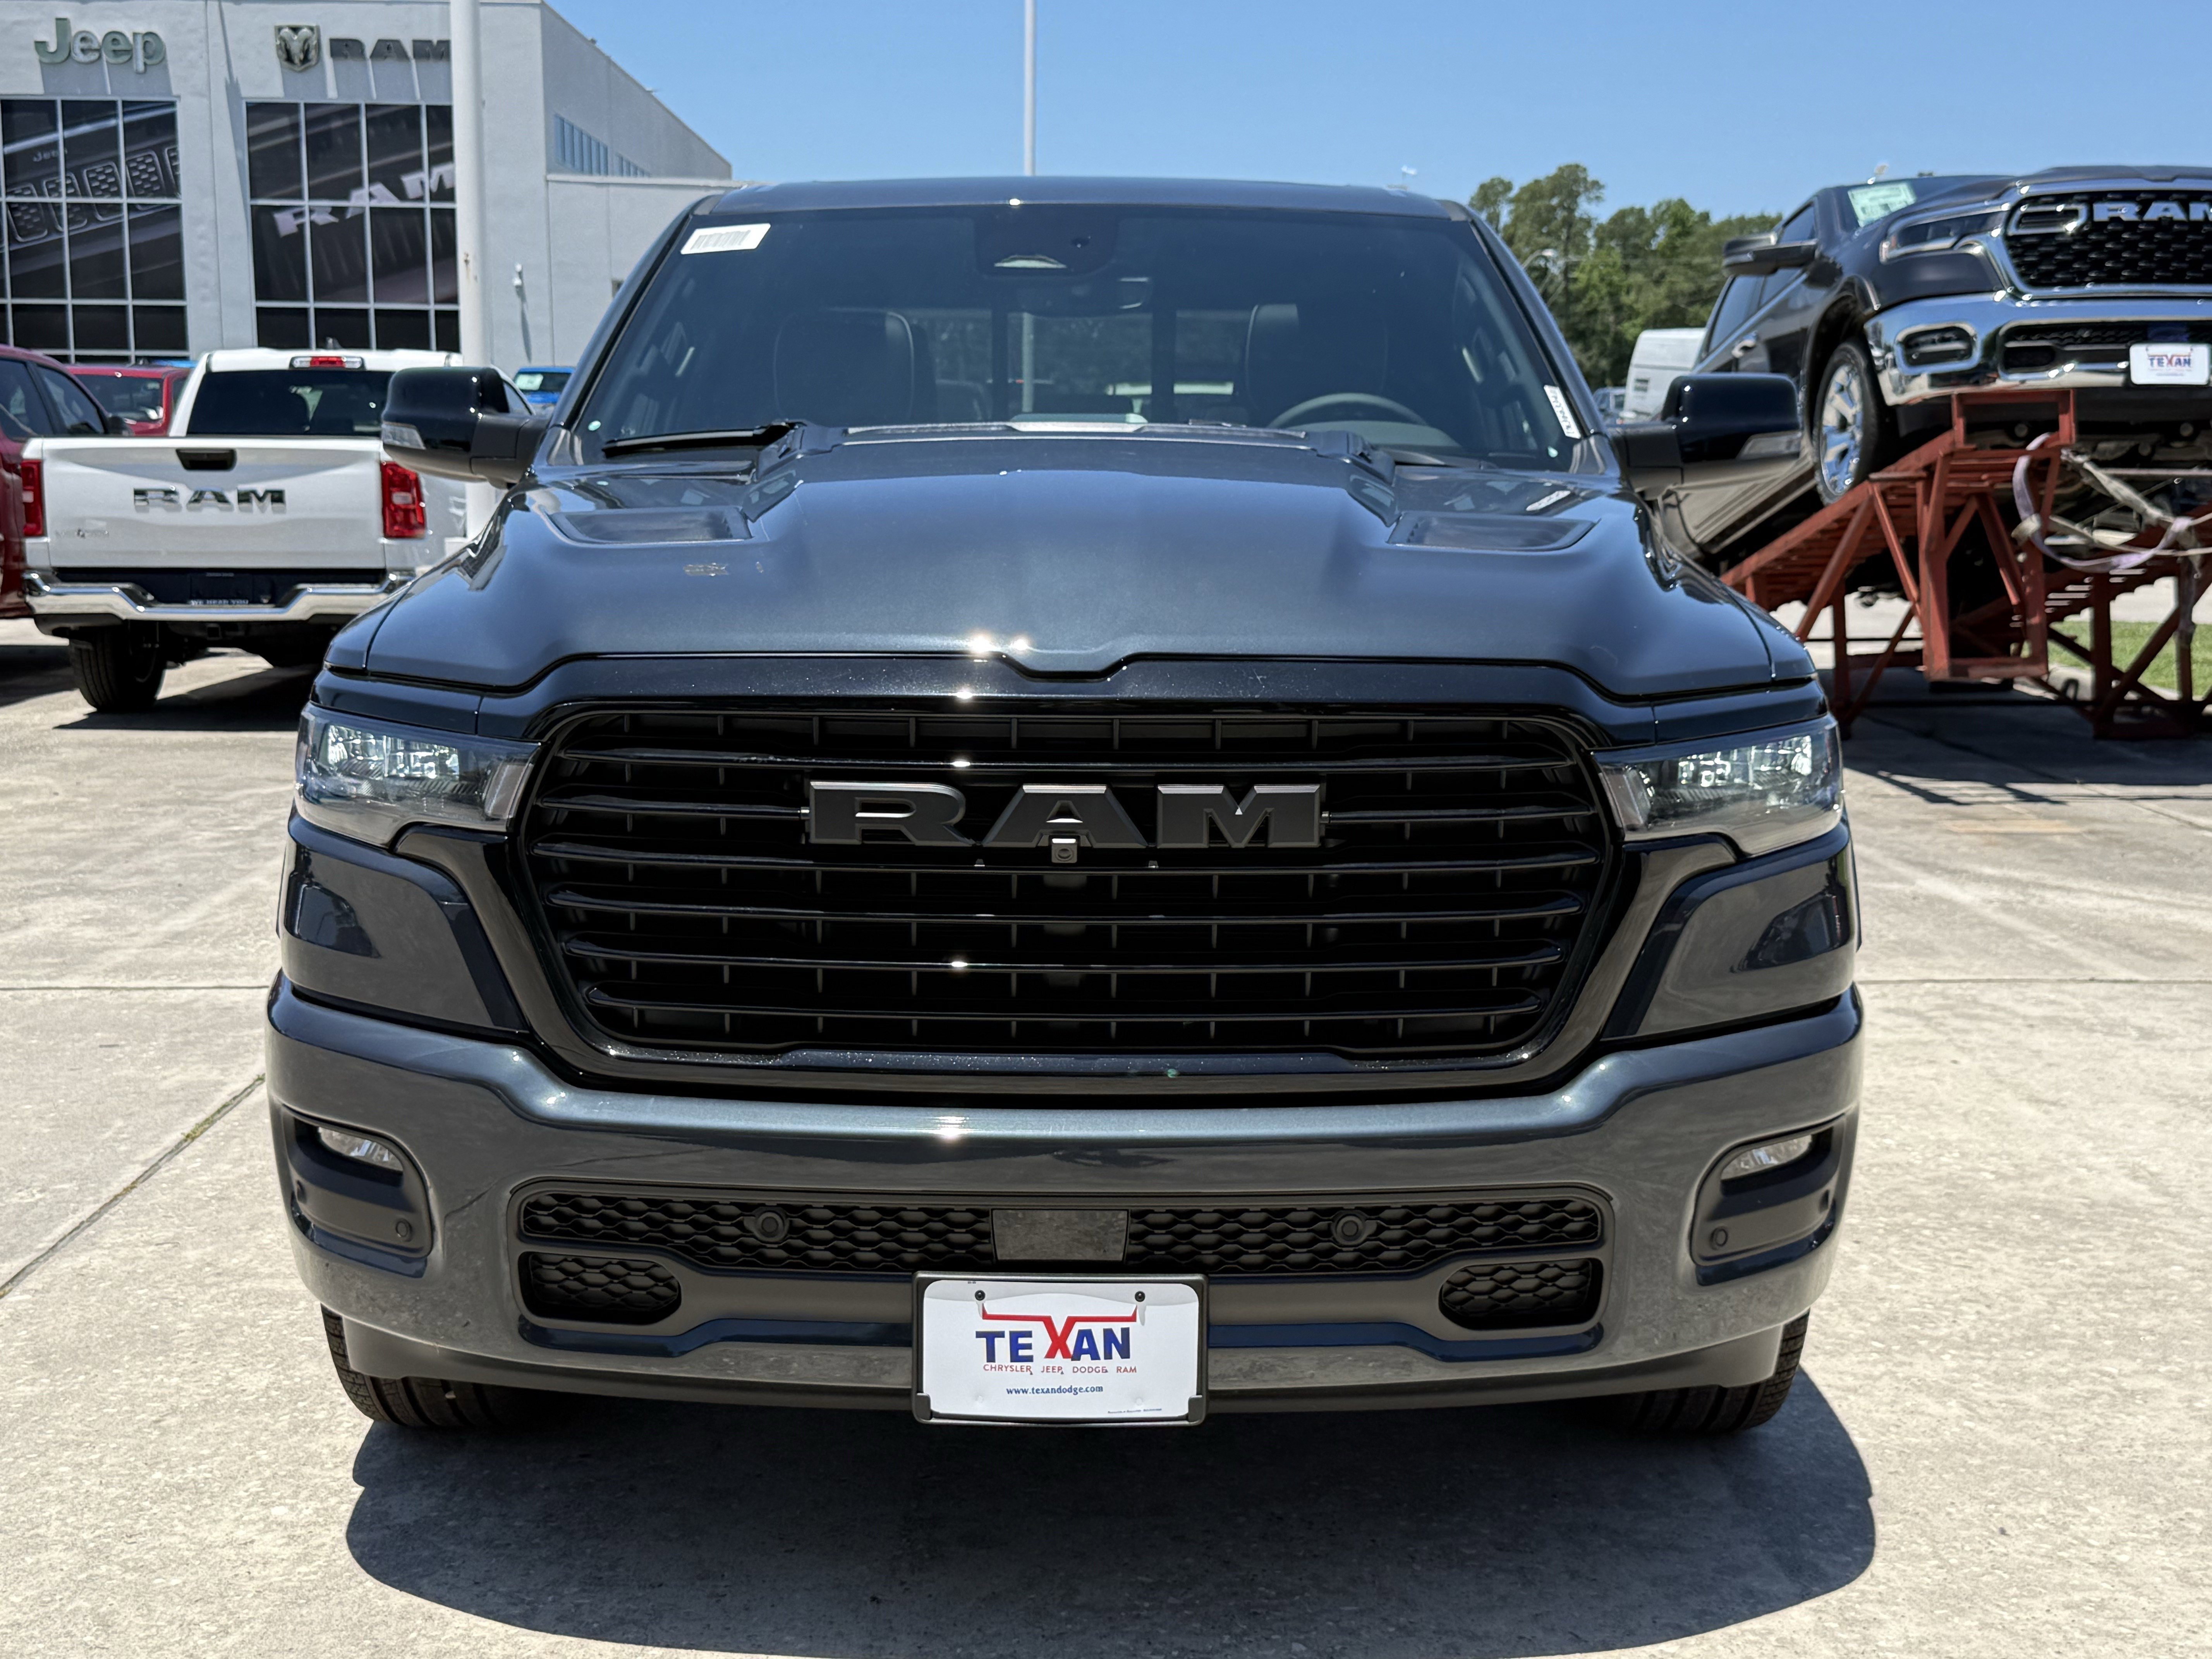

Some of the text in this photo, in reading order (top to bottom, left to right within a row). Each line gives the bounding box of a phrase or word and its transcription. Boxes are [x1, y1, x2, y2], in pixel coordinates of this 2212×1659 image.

[34, 17, 165, 74] Jeep
[329, 38, 451, 60] RAM
[2148, 355, 2191, 368] TEXAN
[134, 488, 286, 505] RAM
[809, 781, 1320, 848] RAM
[975, 1316, 1131, 1363] TEXAN
[1006, 1385, 1104, 1395] www.texandodge.com
